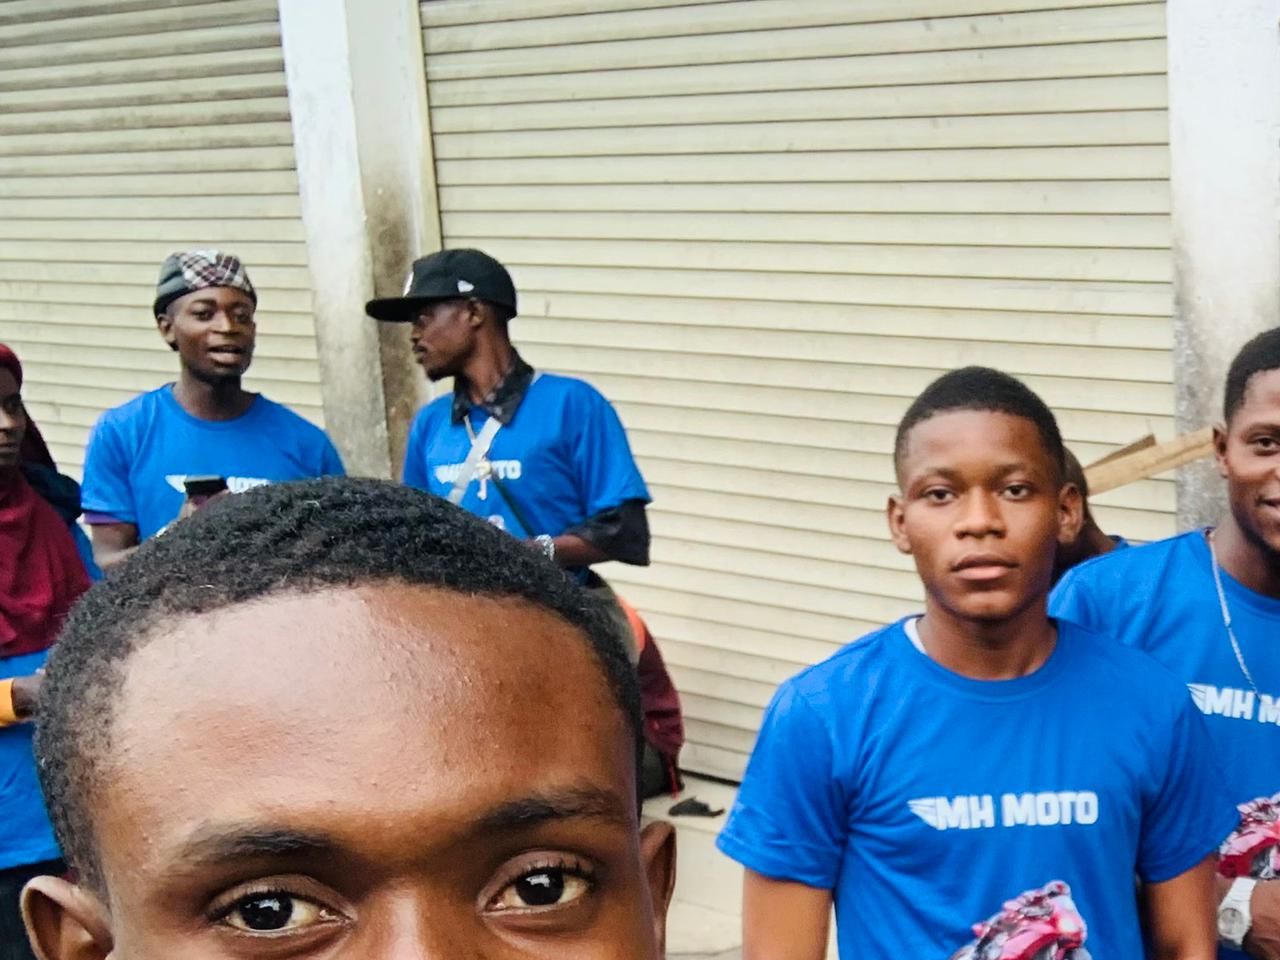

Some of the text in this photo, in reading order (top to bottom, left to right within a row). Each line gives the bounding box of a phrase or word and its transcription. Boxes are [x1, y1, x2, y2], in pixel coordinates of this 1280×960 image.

[1203, 686, 1255, 721] MH
[936, 790, 1099, 831] MH MOTO
